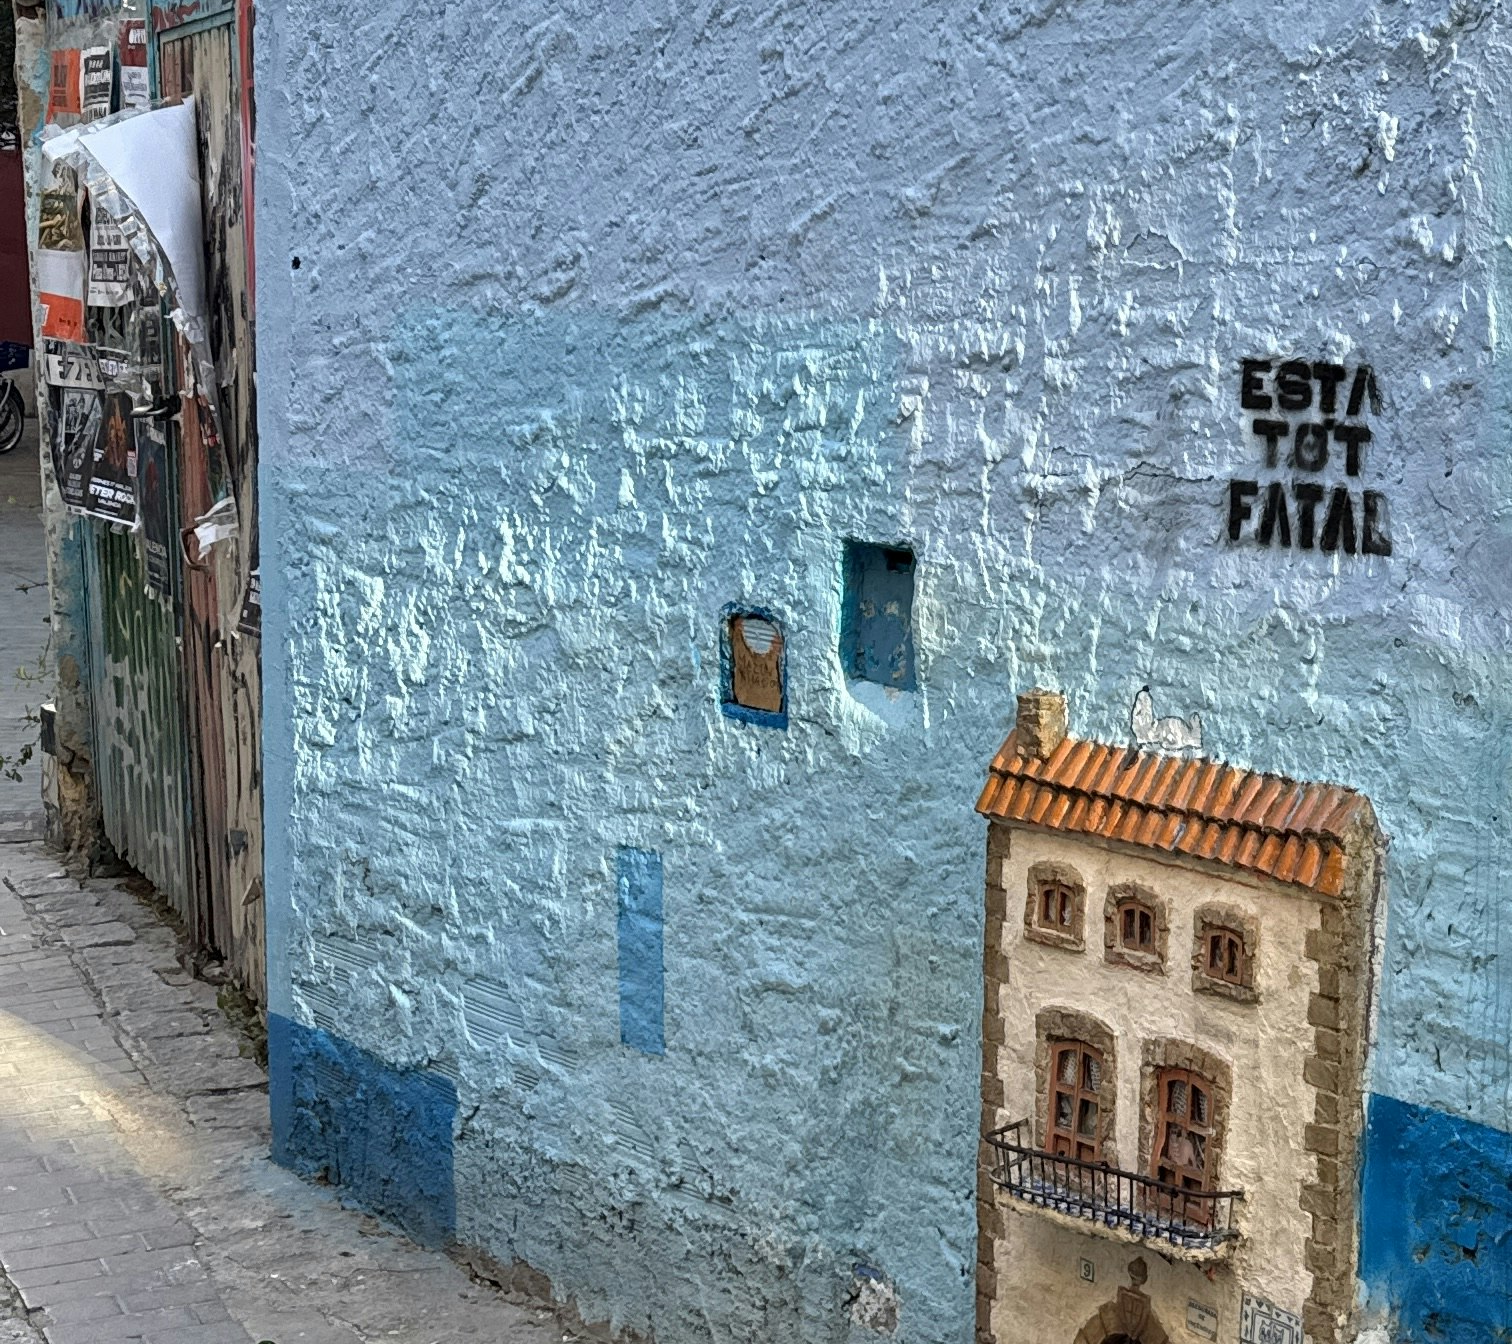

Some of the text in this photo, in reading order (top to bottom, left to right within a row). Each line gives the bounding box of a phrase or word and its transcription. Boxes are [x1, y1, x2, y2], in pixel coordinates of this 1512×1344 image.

[1240, 357, 1384, 416] ESTA
[1252, 418, 1372, 477] TOT
[1228, 478, 1393, 557] FATAL
[1083, 1263, 1091, 1278] 9
